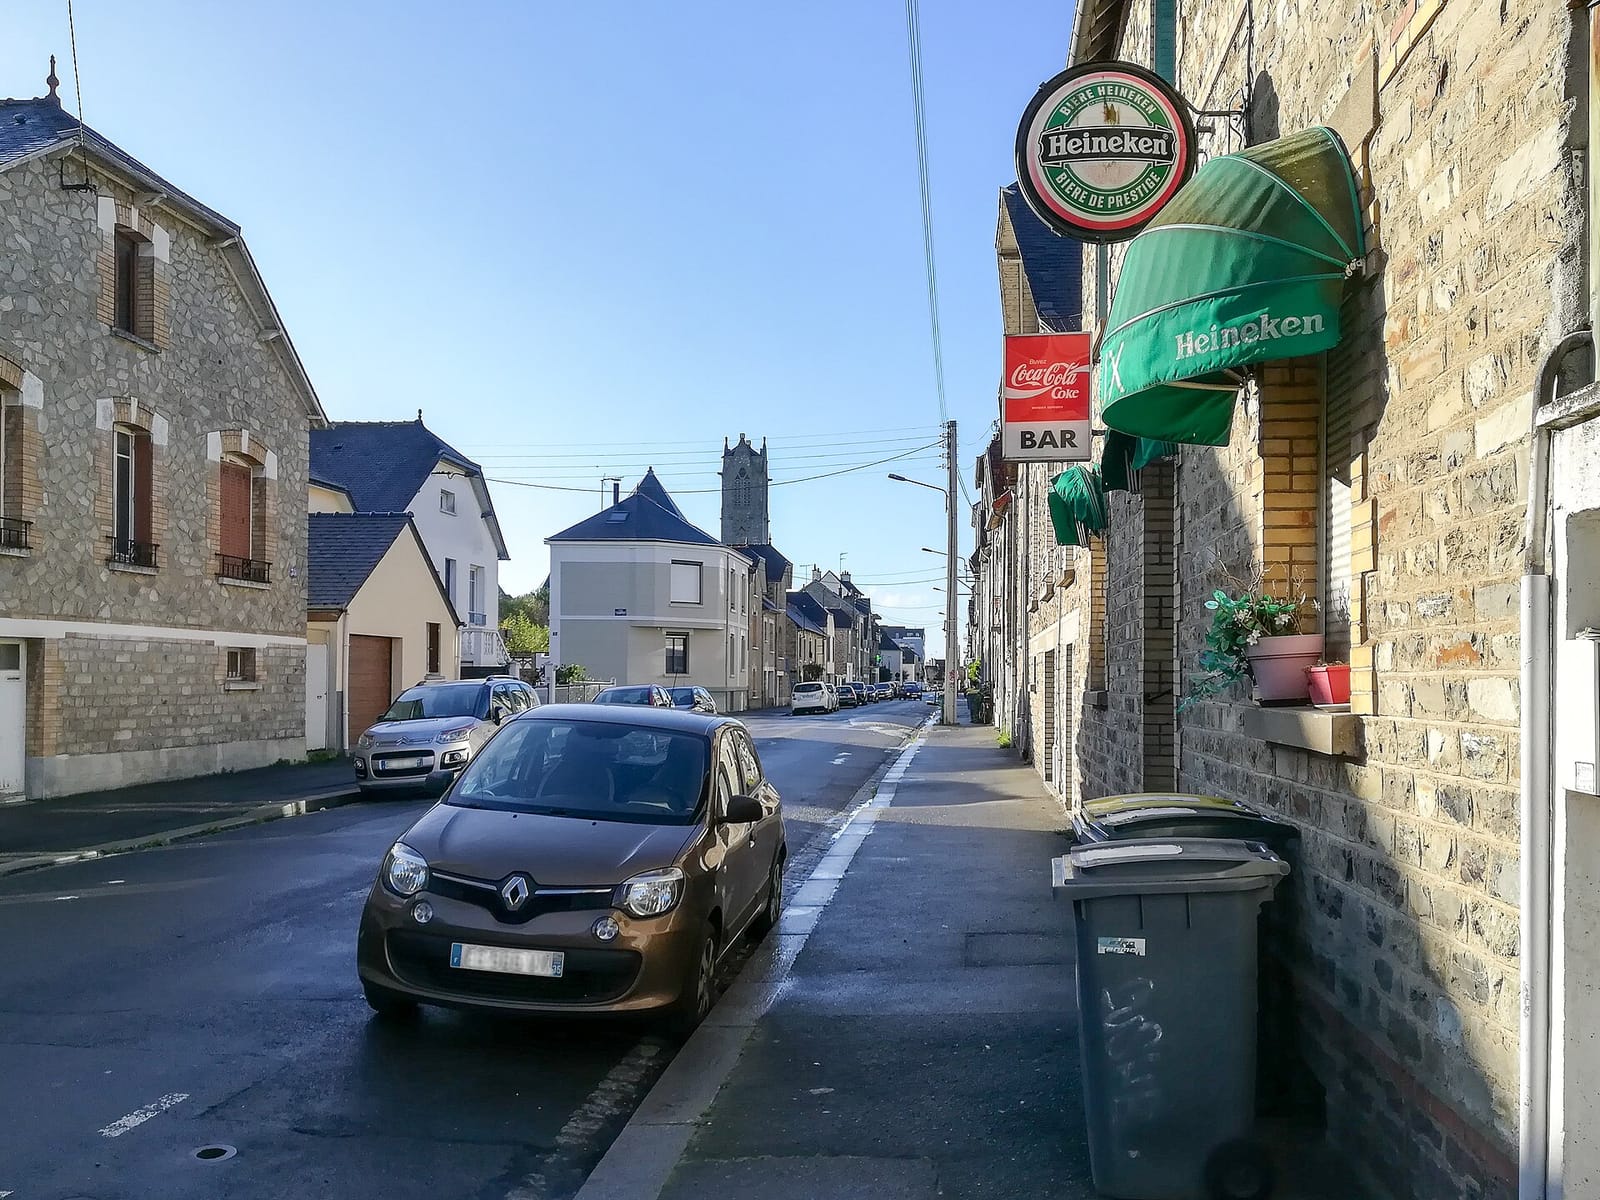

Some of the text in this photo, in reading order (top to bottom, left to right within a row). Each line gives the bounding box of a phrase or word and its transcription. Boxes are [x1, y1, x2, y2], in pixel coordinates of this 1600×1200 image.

[1097, 85, 1157, 115] HEINEKEN
[1048, 131, 1169, 157] Heineken
[1055, 171, 1161, 209] BIERE DE PRESTIGE
[1174, 313, 1325, 361] Heineken
[1051, 386, 1080, 399] Coke
[1020, 430, 1078, 449] BAR
